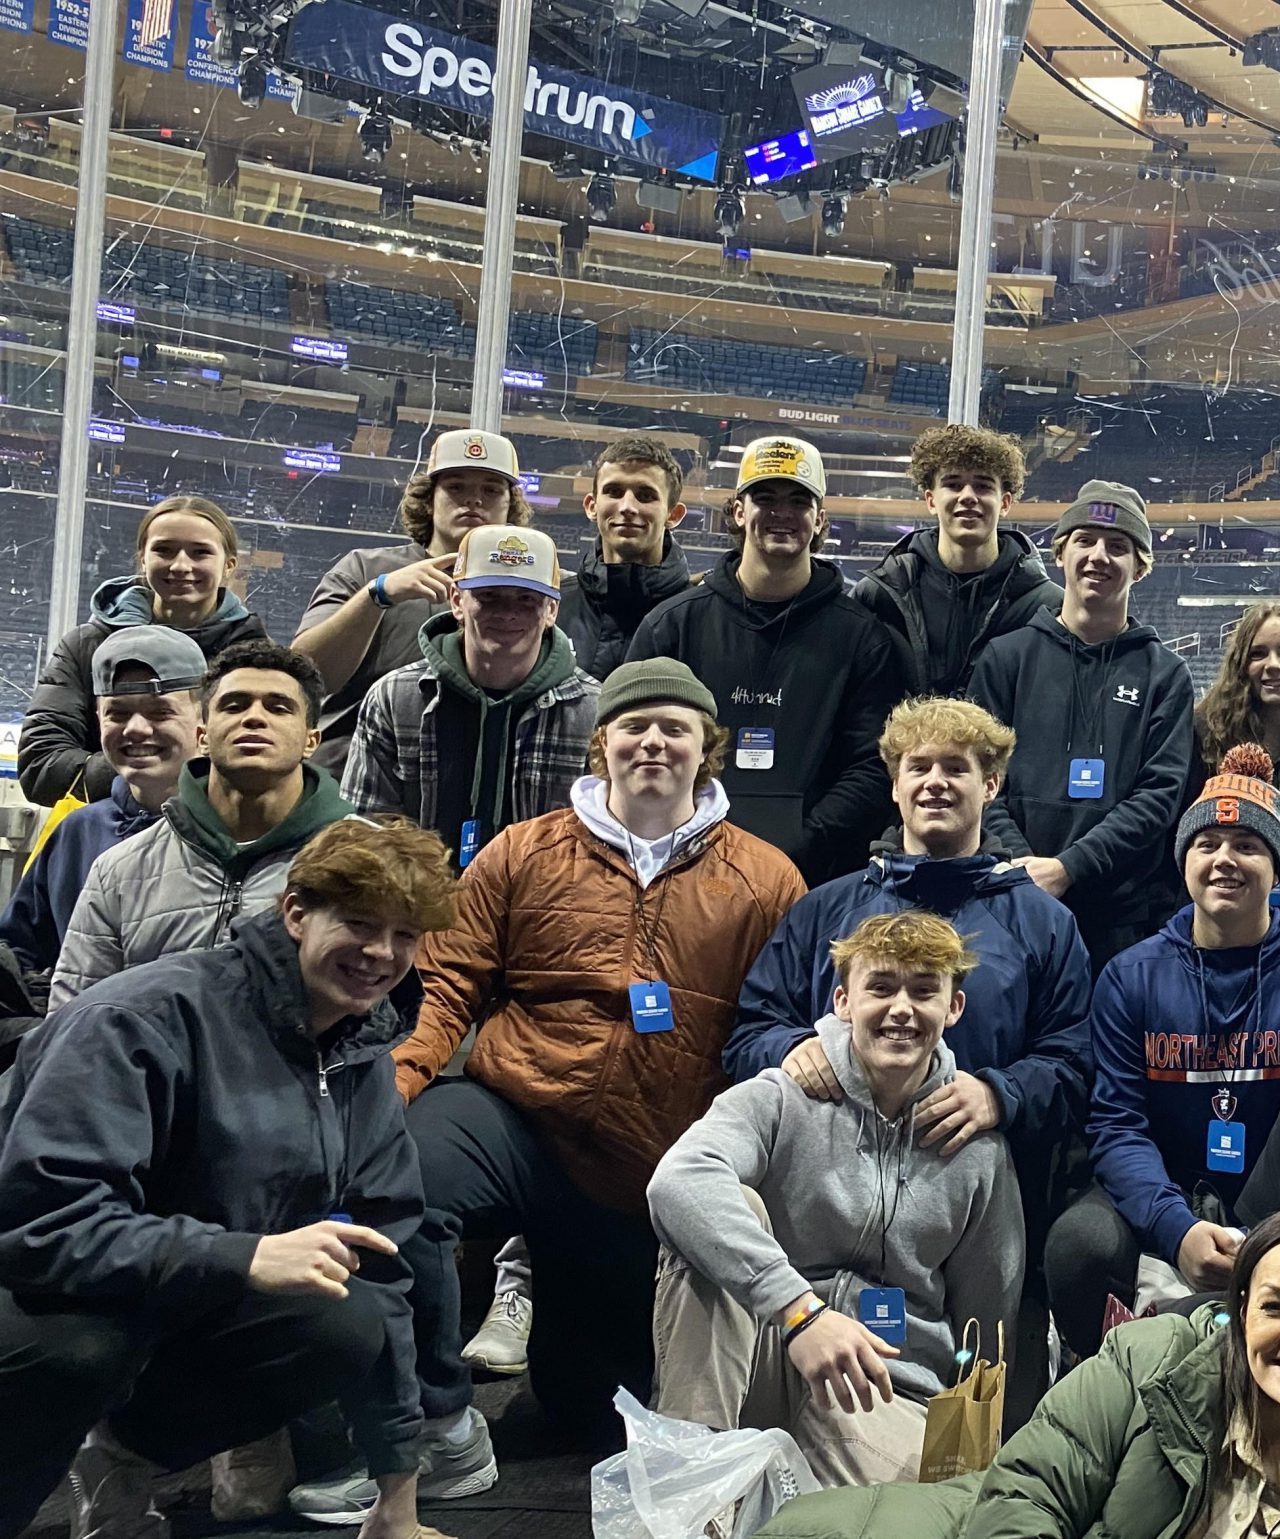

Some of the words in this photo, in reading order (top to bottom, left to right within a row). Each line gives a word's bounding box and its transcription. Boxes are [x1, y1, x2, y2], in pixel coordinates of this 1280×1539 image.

[56, 0, 89, 18] 1952-5
[52, 31, 89, 48] CHAMPION
[133, 43, 164, 58] DIVISION
[126, 51, 169, 68] CHAMPIONS
[187, 59, 240, 77] CONFERENC
[189, 69, 235, 85] CHAMPIONS
[381, 22, 637, 141] Spetrum
[778, 408, 804, 419] BUD
[805, 411, 840, 423] LIGHT
[1204, 774, 1277, 806] RANGE
[1144, 1030, 1248, 1070] NORTHEAST
